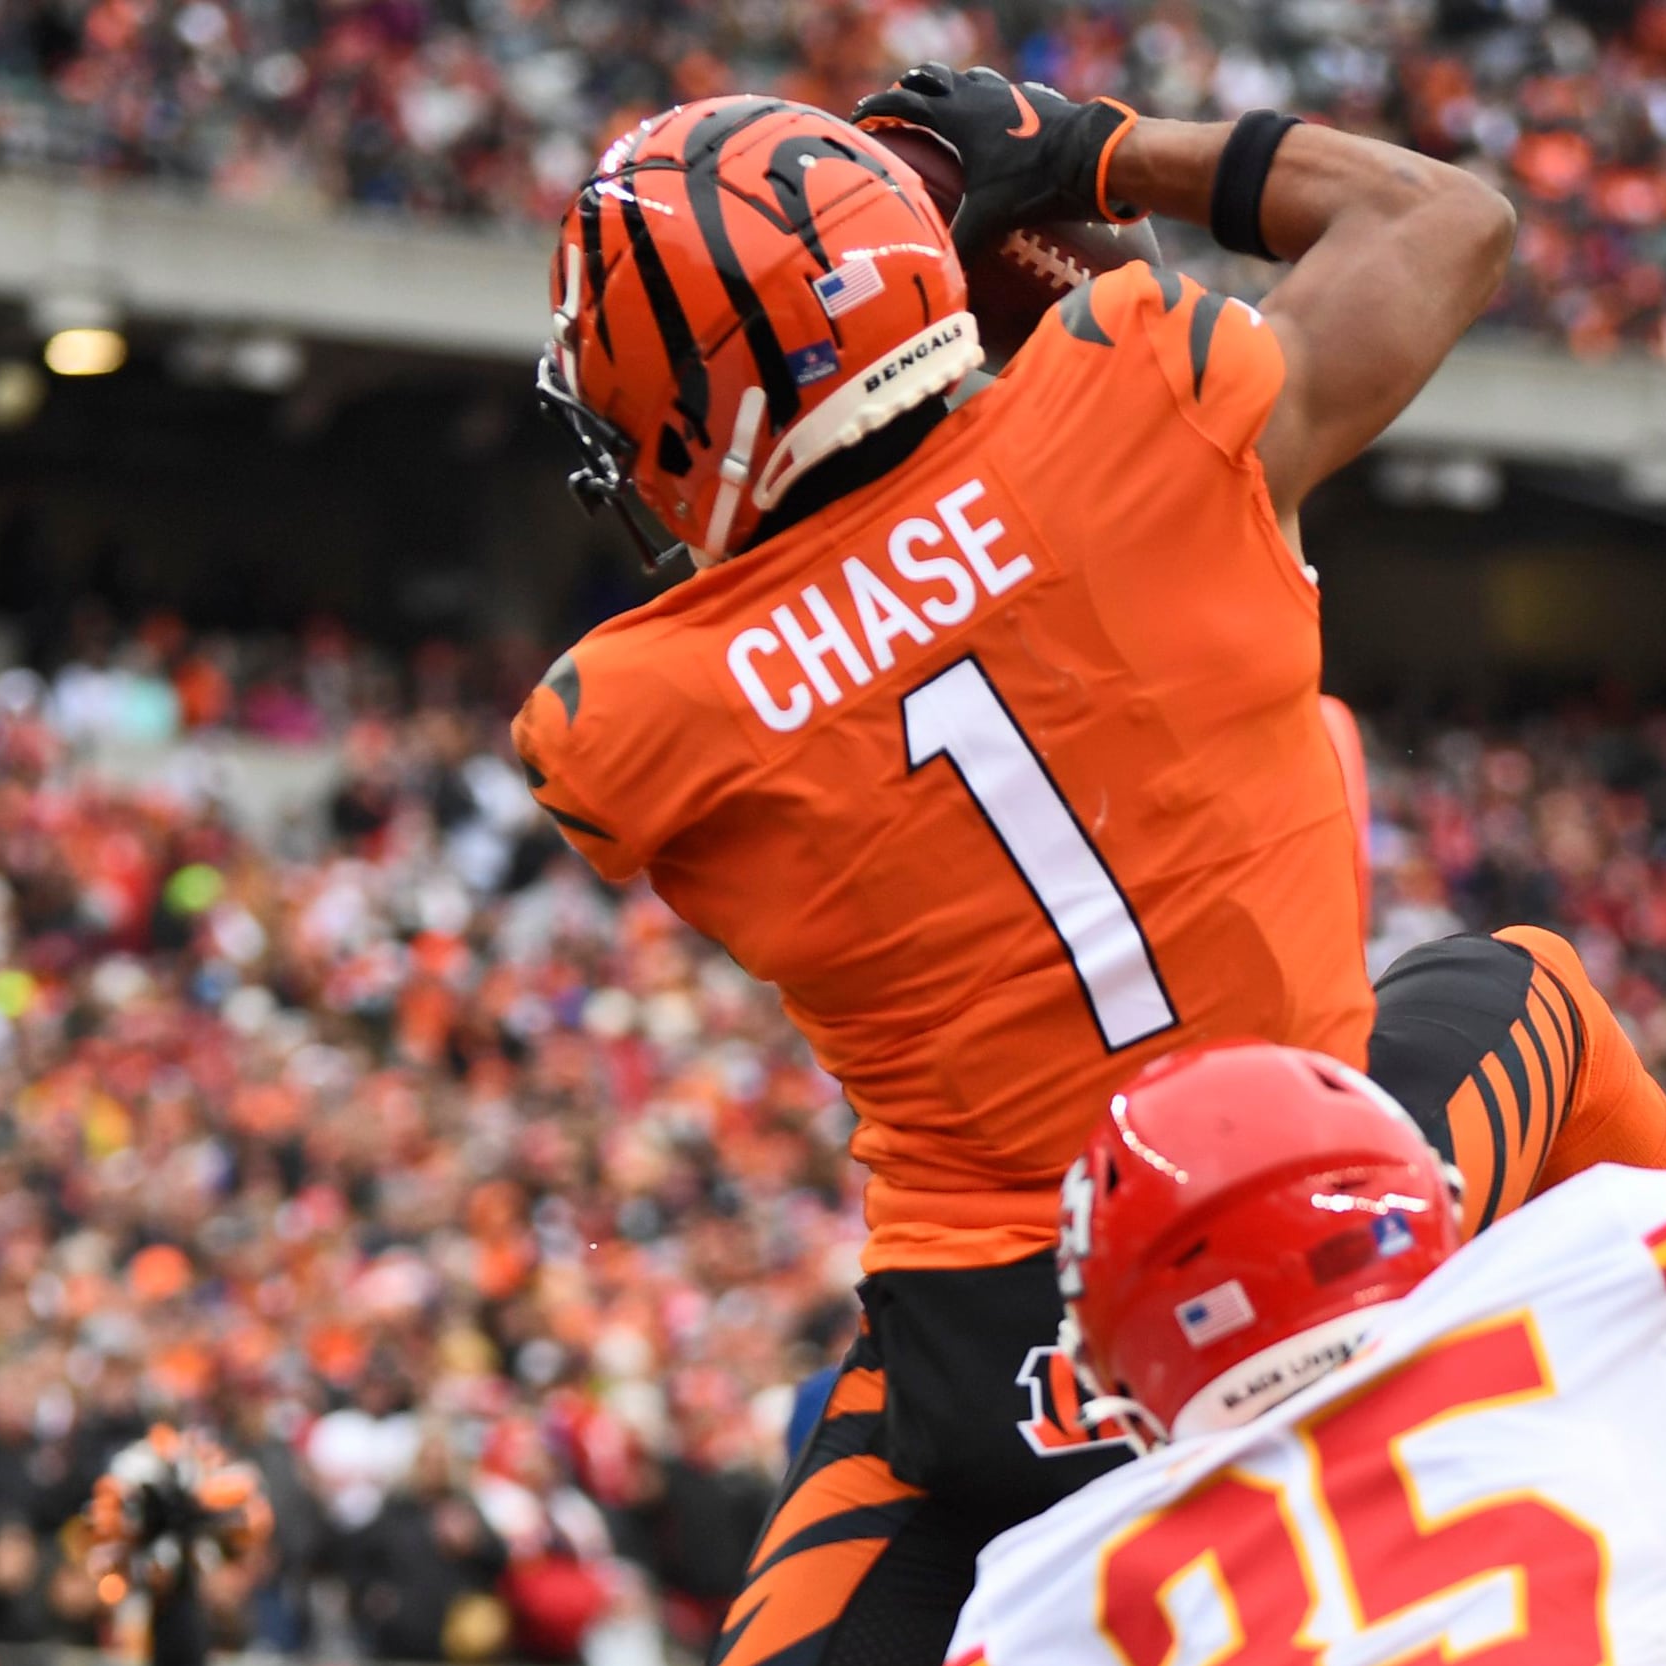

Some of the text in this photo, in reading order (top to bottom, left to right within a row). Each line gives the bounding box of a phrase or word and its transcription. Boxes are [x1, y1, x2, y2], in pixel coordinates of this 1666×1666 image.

[864, 323, 963, 393] BENGALS
[727, 478, 1033, 733] CHASE
[900, 653, 1178, 1053] 1
